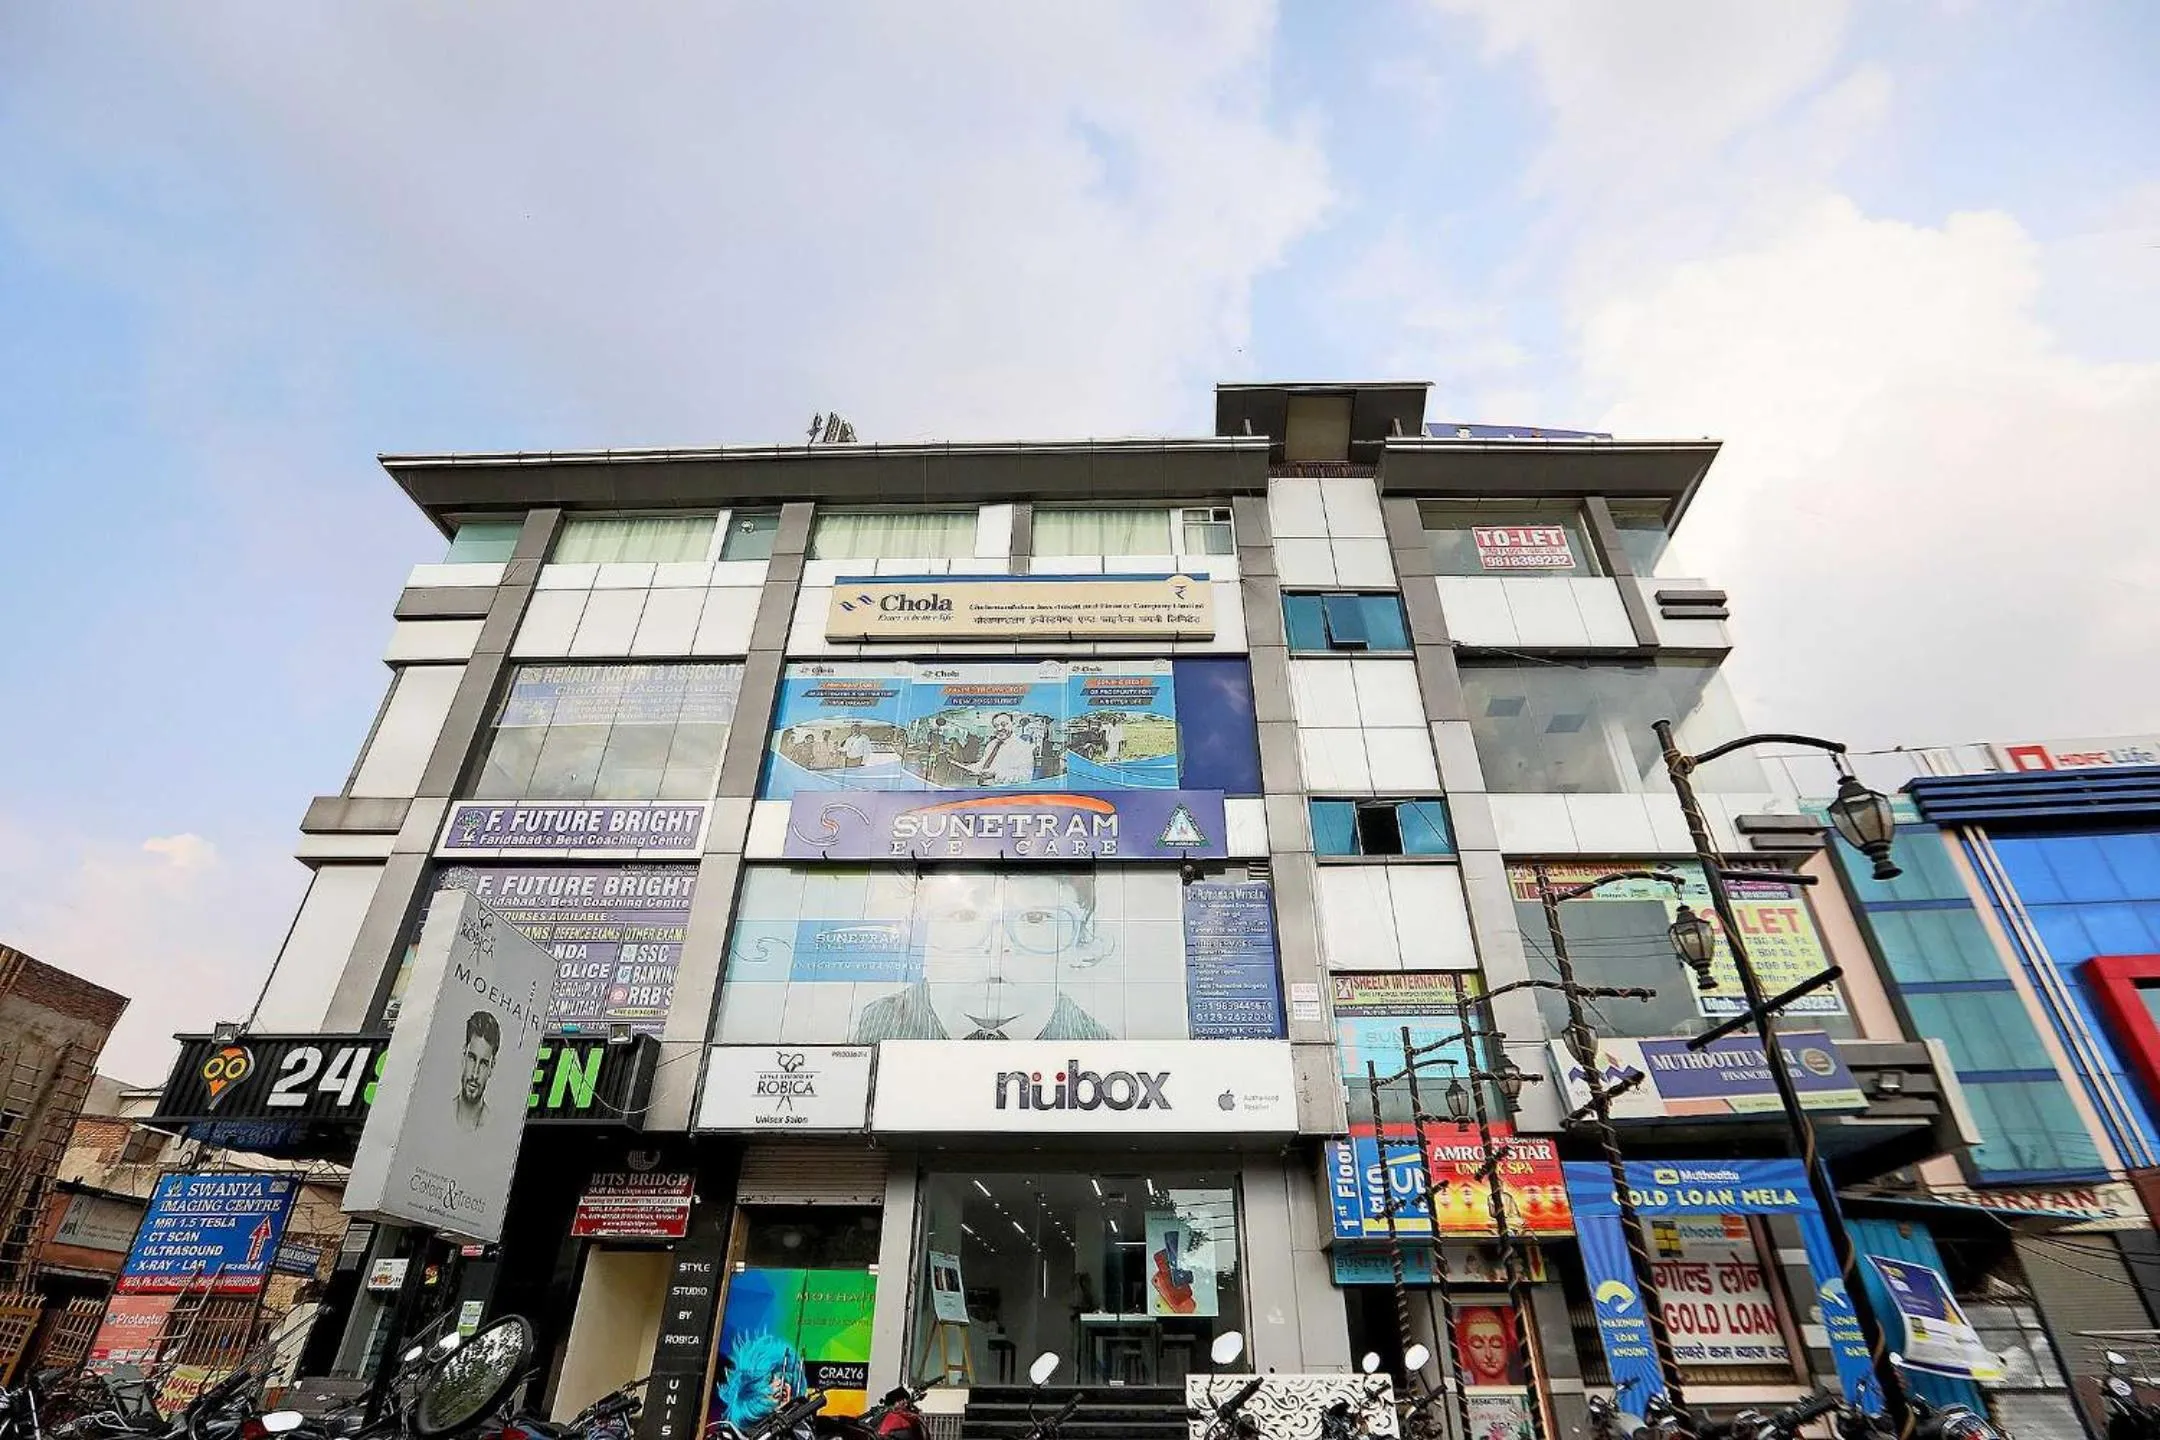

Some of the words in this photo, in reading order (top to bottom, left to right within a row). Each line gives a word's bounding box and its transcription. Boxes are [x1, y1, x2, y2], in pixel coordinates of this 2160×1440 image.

[1477, 529, 1560, 546] TO-LET
[879, 594, 954, 612] Chola
[510, 810, 604, 832] FUTURE
[608, 810, 699, 833] BRIGHT
[890, 813, 1121, 840] SUNETRAM
[479, 834, 553, 846] Faridabad's
[555, 834, 586, 846] Best
[587, 834, 646, 848] Coaching
[649, 834, 693, 846] Centre
[890, 840, 965, 856] EYE
[1016, 839, 1119, 856] CARE
[501, 876, 598, 896] FUTURE
[603, 875, 696, 897] BRIGHT
[481, 896, 548, 908] aridabad's
[550, 897, 579, 907] Best
[582, 897, 643, 908] Coaching
[646, 898, 690, 908] Centre
[505, 912, 548, 921] OURSES
[549, 912, 608, 921] AVAILABLE
[624, 926, 657, 941] OTHER
[815, 933, 901, 944] SUNETRAM
[553, 944, 588, 960] NDA
[637, 944, 671, 963] SSC
[560, 962, 611, 979] OLICE
[633, 965, 679, 984] BANKIN
[1651, 1050, 1756, 1071] MUTHOOTTU
[757, 1081, 815, 1095] ROBICA
[1505, 1144, 1553, 1160] STAR
[1335, 1140, 1357, 1198] Floor
[1506, 1161, 1534, 1175] SPA
[591, 1172, 626, 1186] BITS
[628, 1172, 690, 1187] BRIDGE
[187, 1182, 264, 1197] SWANYA
[1675, 1188, 1736, 1206] LOAN
[1741, 1188, 1800, 1205] MELA
[159, 1200, 223, 1213] IMAGING
[224, 1199, 282, 1212] CENTRE
[153, 1218, 177, 1229] MRI
[179, 1218, 197, 1228] 1.5
[199, 1217, 236, 1228] TESLA
[150, 1232, 166, 1243] CT
[168, 1232, 201, 1243] SCAN
[143, 1245, 224, 1257] ULTRASOUND
[137, 1260, 173, 1271] X-RAY
[679, 1262, 711, 1273] STYLE
[671, 1286, 708, 1296] STUDIO
[678, 1311, 693, 1320] BY
[1663, 1302, 1721, 1335] GOLD
[1722, 1302, 1777, 1335] LOAN
[664, 1334, 701, 1345] ROBICA
[818, 1365, 865, 1380] CRAZY6
